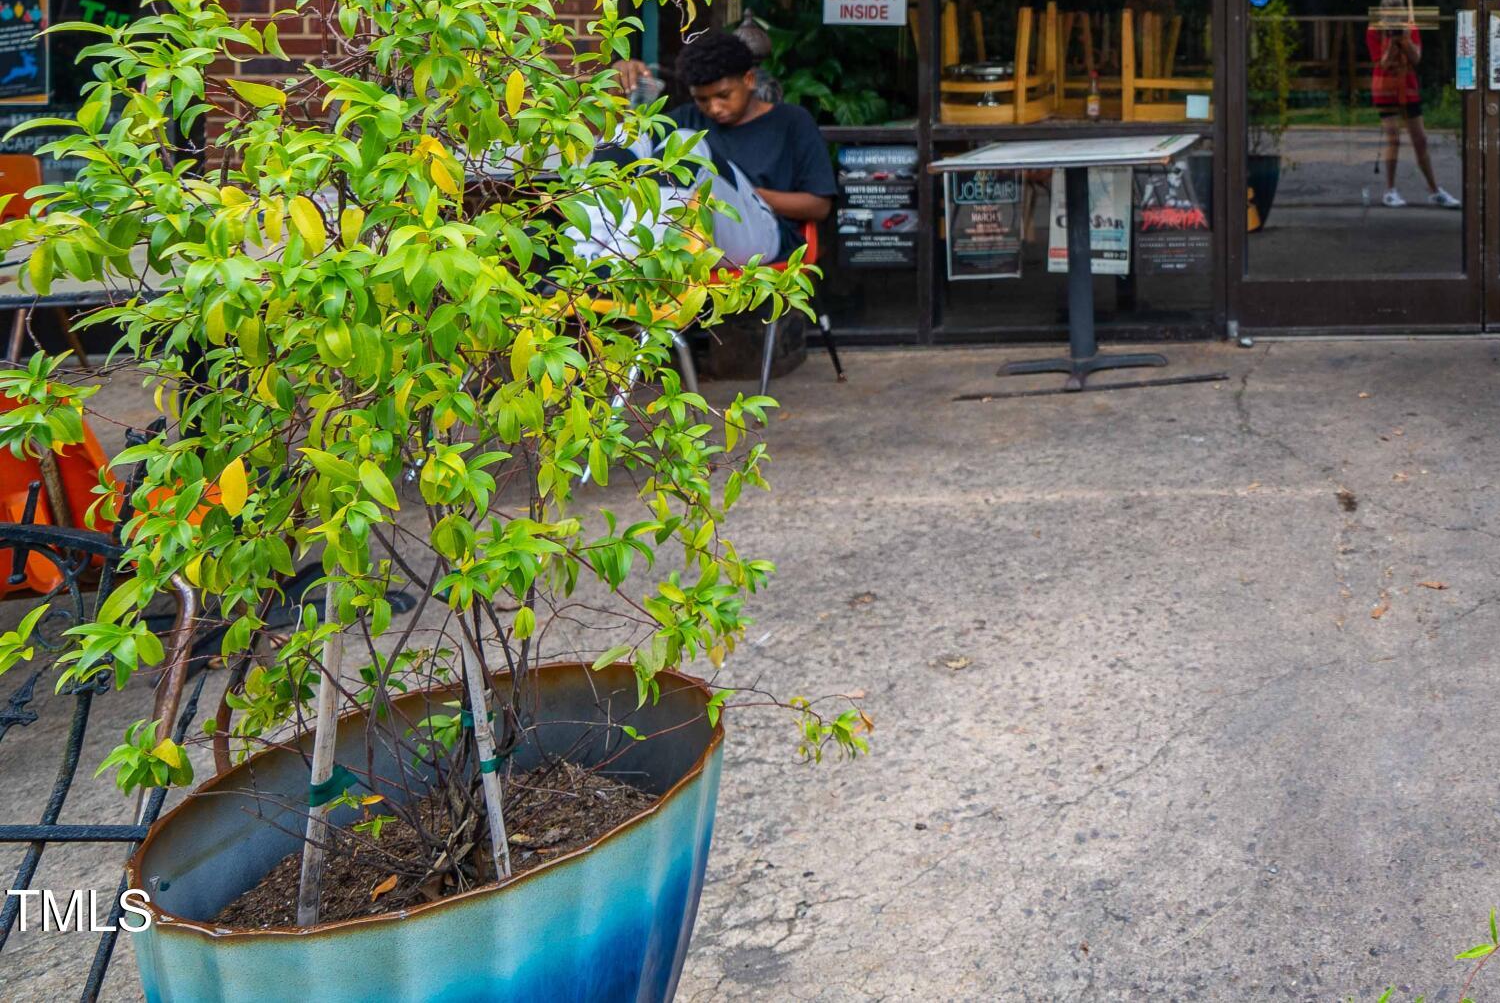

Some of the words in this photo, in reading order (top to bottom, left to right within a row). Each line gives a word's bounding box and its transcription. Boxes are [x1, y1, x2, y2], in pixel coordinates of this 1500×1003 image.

[840, 4, 889, 20] INSIDE
[959, 181, 984, 200] JOB
[986, 180, 1016, 199] FAIR
[971, 211, 996, 223] MARCH
